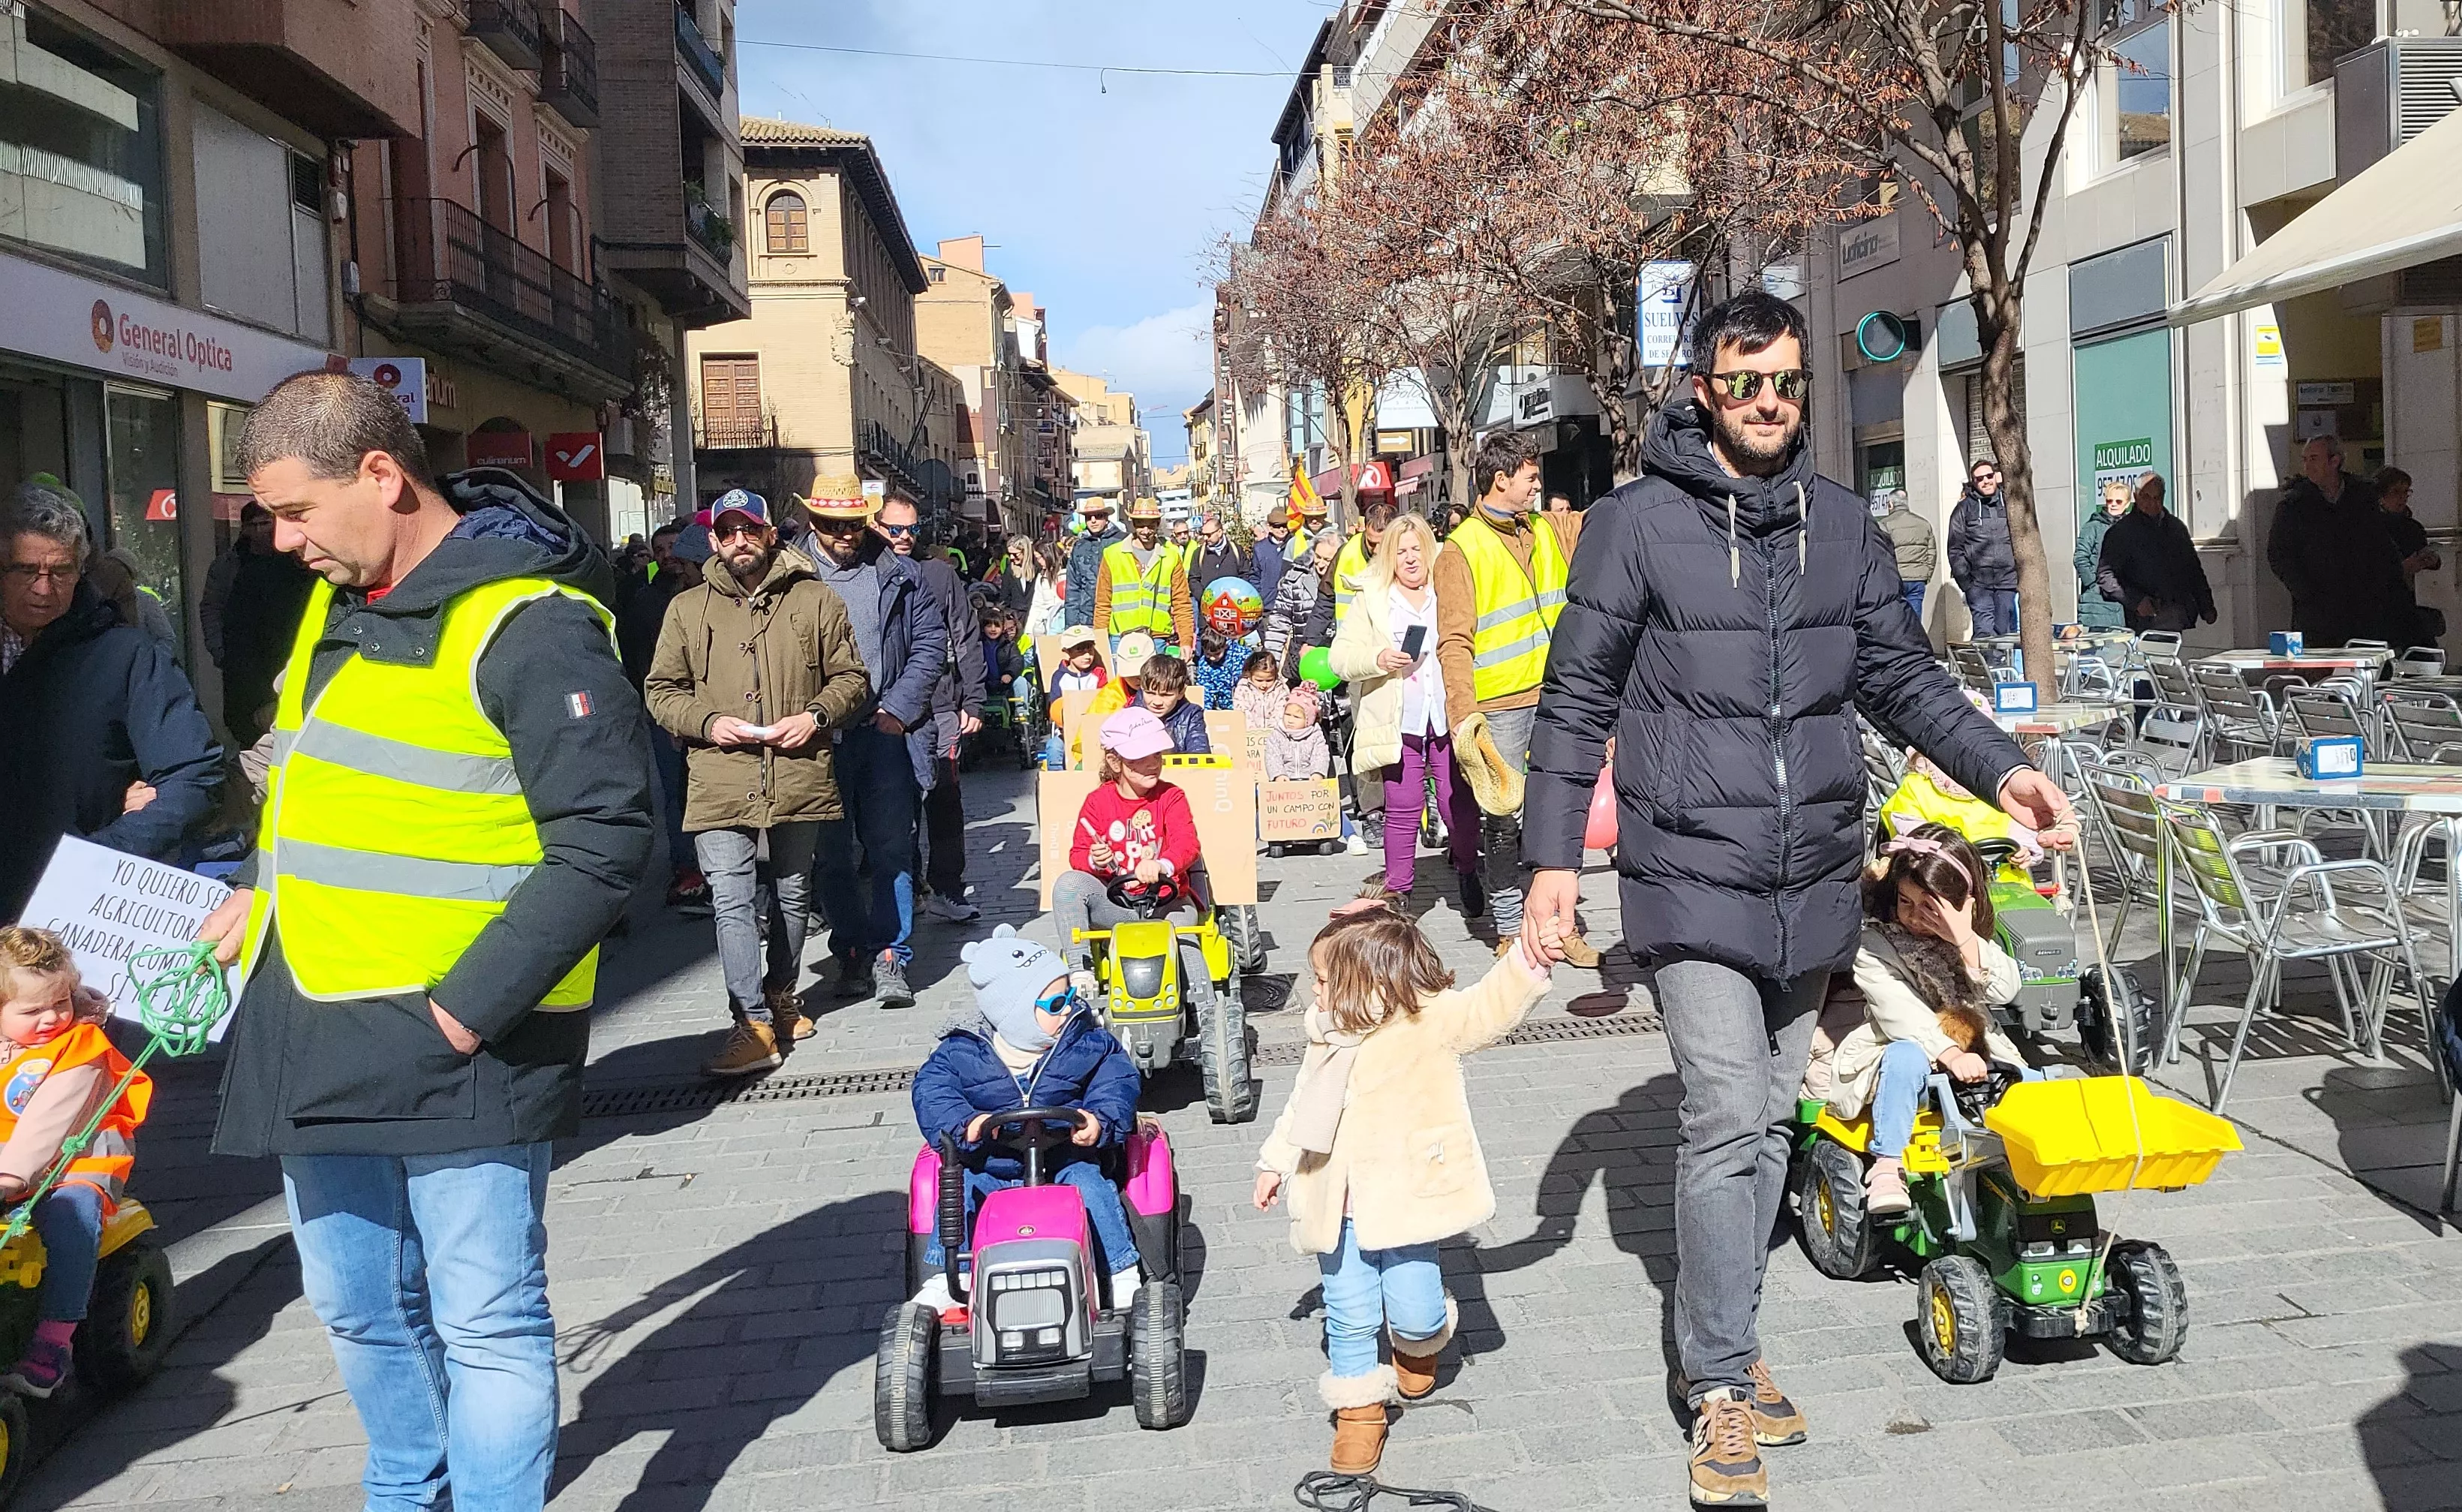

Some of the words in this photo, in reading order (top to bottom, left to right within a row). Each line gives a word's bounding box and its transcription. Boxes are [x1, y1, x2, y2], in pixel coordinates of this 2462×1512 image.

[119, 312, 182, 360] General
[187, 332, 233, 372] Optica
[1649, 350, 1659, 358] DE
[2097, 443, 2151, 467] ALQUILADO
[1871, 470, 1903, 489] ALQUILADO
[1266, 790, 1304, 802] JUNTOS
[1311, 790, 1330, 801] POR
[1267, 806, 1278, 814] UN
[1284, 804, 1315, 813] CAMPO
[1318, 802, 1335, 810] CON
[1266, 819, 1306, 831] FUTURO
[112, 858, 135, 885] YO
[137, 867, 200, 905] QUIERO
[106, 972, 131, 1000] SI
